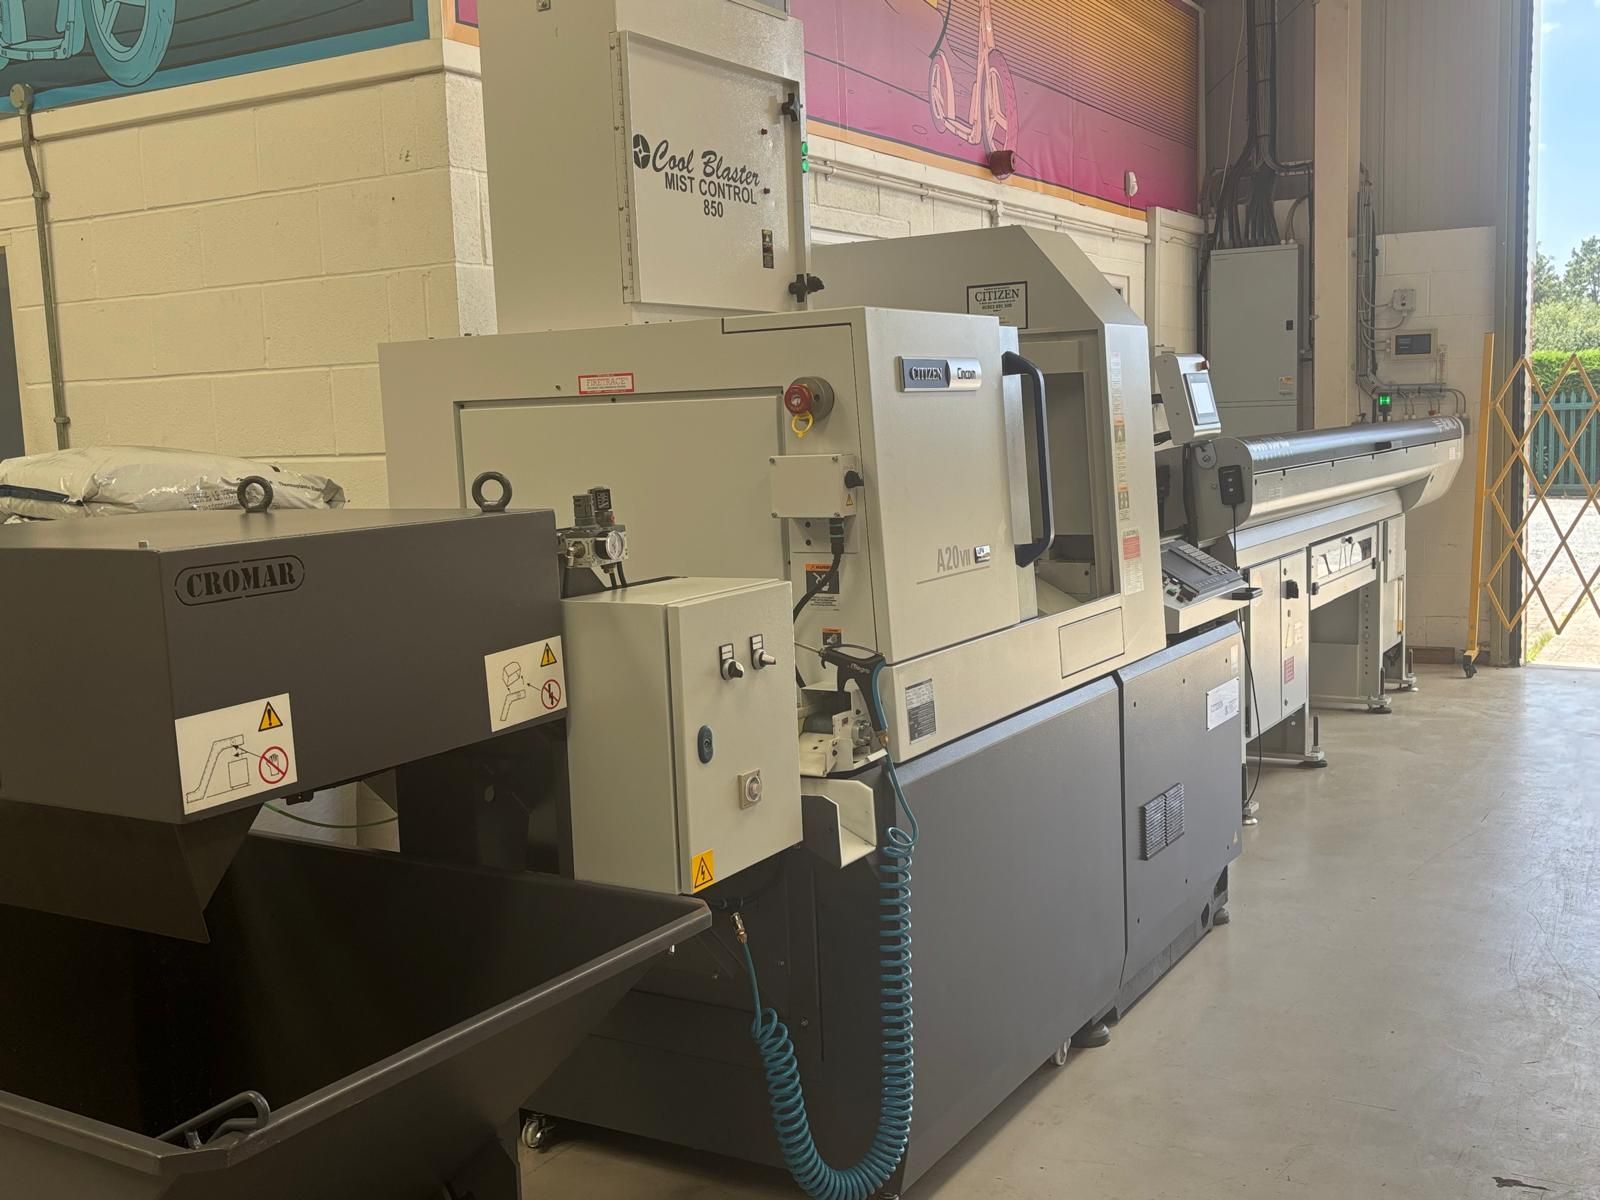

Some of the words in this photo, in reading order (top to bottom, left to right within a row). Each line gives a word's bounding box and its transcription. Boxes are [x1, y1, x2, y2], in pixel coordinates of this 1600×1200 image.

[652, 139, 694, 173] Cool
[701, 150, 760, 187] Blaster
[664, 171, 695, 194] MIST
[699, 179, 758, 205] CONTROL
[703, 199, 724, 218] 850
[974, 288, 1020, 302] CITIZEN
[909, 366, 943, 381] CITIZEN
[186, 562, 297, 598] CROMAR
